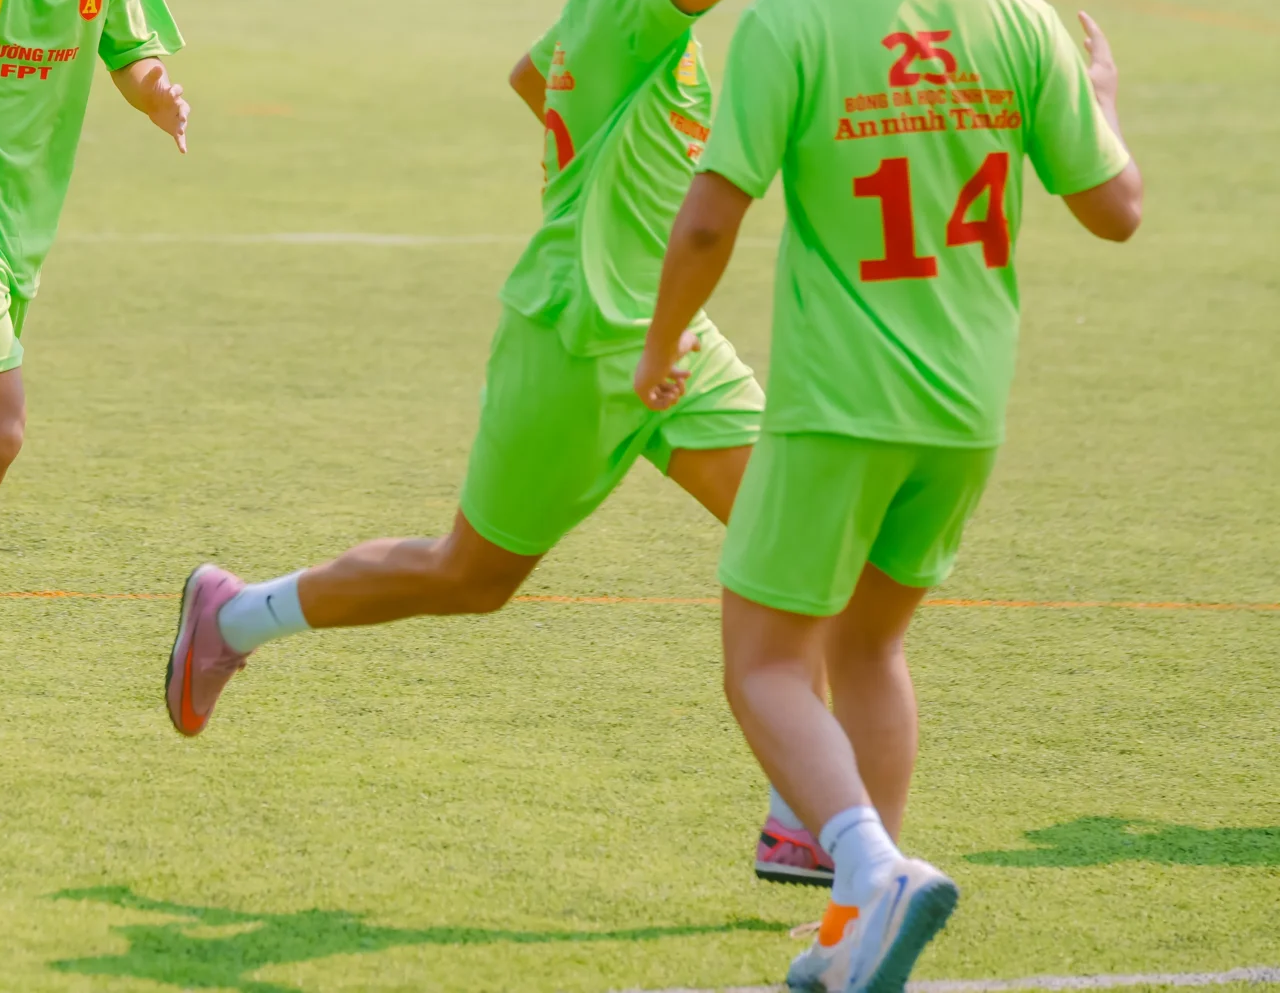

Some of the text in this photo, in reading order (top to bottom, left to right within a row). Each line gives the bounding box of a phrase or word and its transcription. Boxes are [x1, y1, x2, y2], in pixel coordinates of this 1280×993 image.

[0, 63, 53, 80] FPT
[47, 46, 80, 62] THPT
[881, 30, 957, 88] 25
[853, 152, 1010, 282] 14
